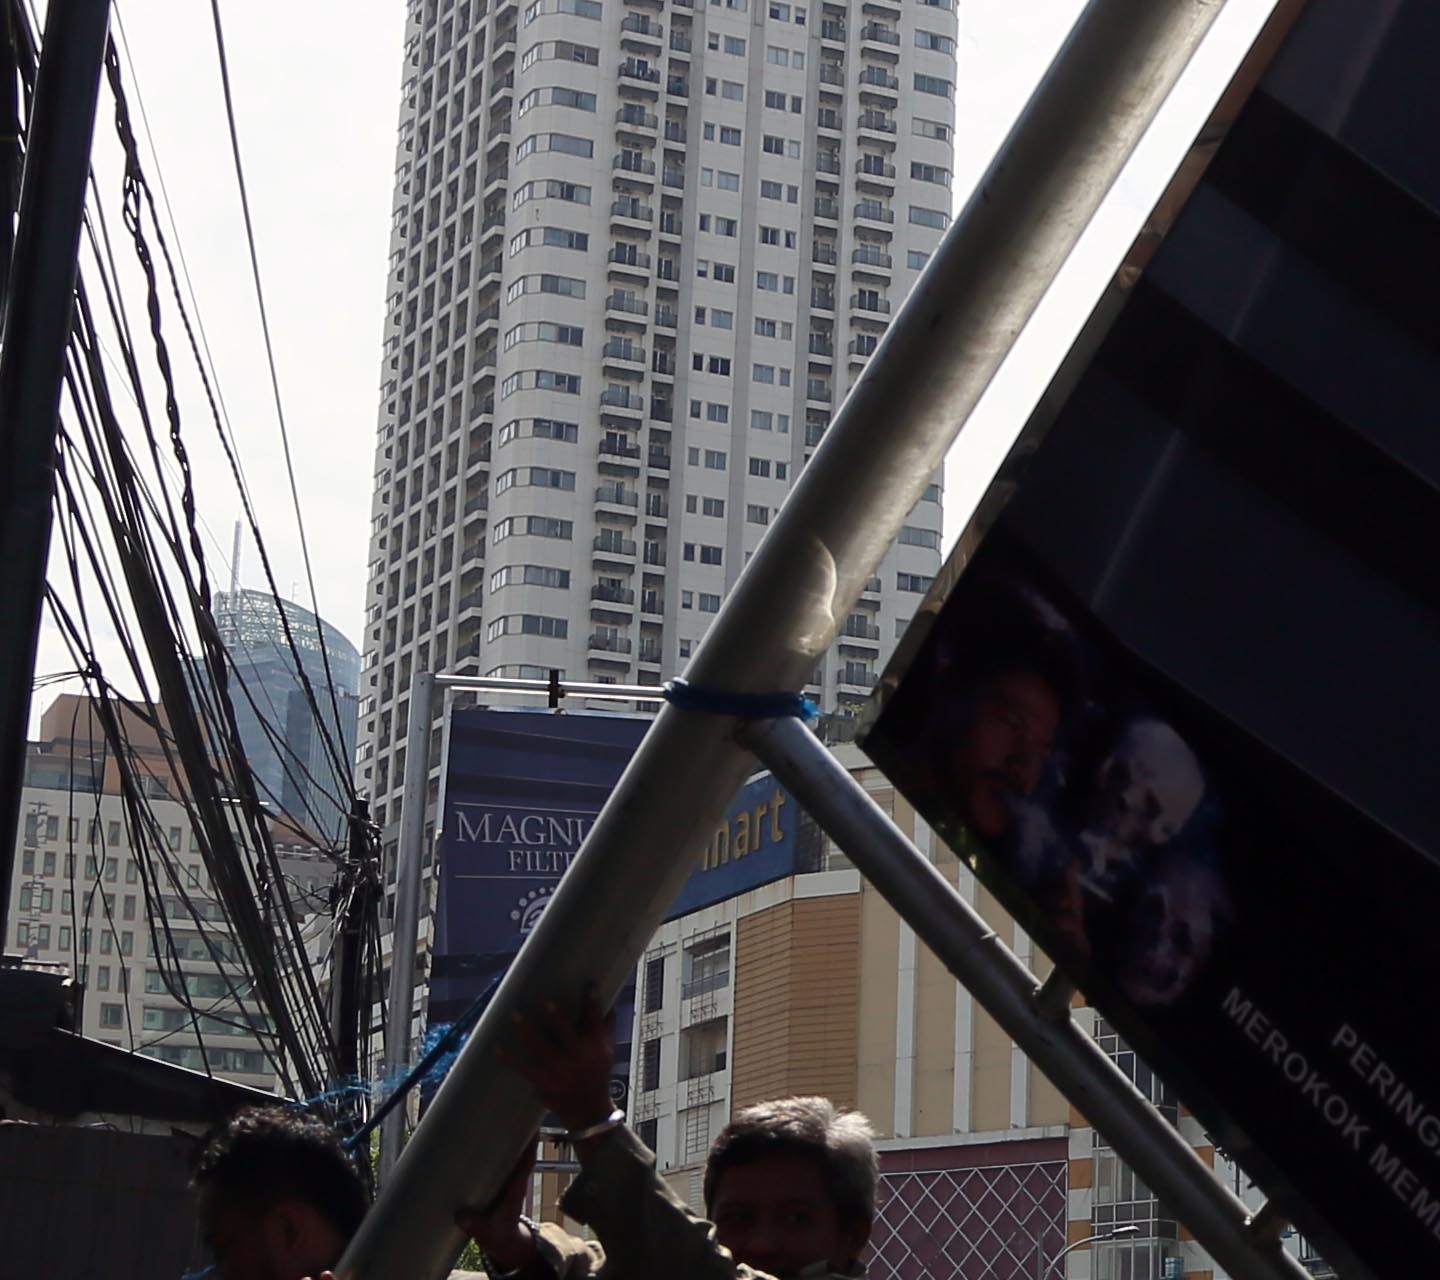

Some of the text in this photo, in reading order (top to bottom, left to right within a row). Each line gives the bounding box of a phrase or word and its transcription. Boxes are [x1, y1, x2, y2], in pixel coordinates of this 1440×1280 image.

[455, 811, 600, 846] MAGNU
[508, 849, 576, 872] FILTE
[1219, 985, 1372, 1151] MEROKOK
